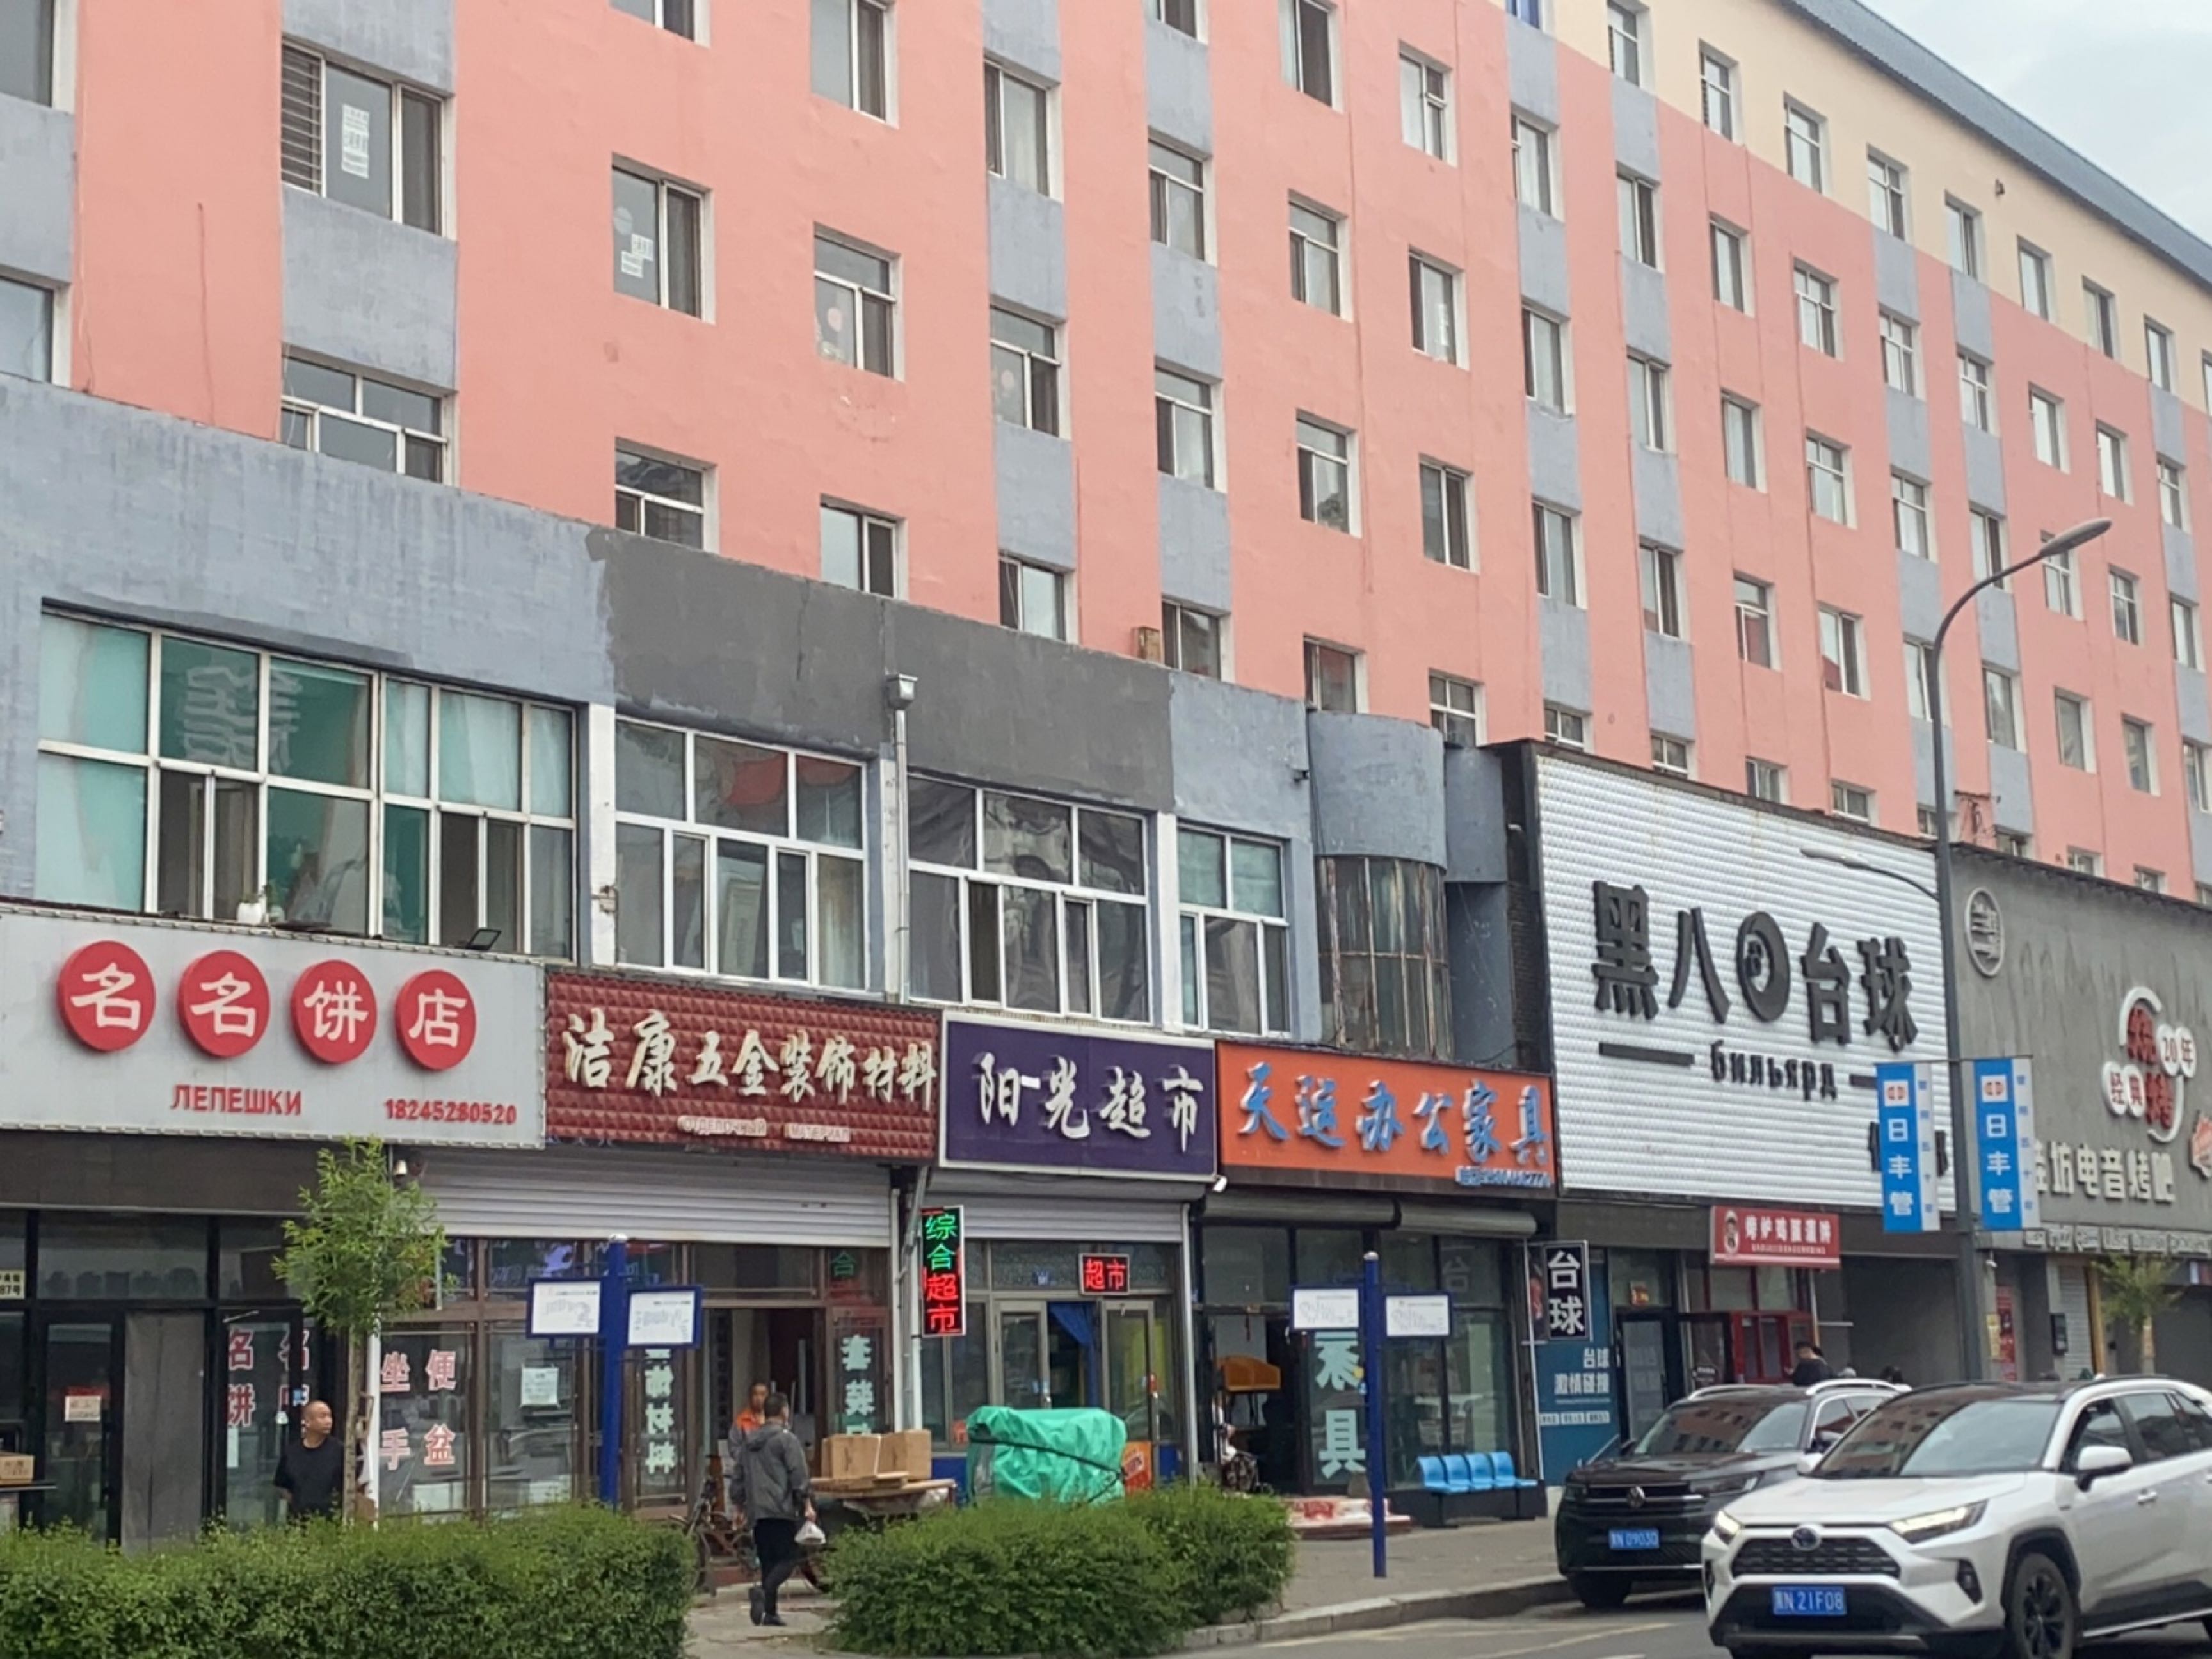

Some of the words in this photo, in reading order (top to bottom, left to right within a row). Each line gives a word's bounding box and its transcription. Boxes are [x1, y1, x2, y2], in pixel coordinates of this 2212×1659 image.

[71, 961, 467, 1047] 名名饼店
[170, 1084, 301, 1116] ЛЕПЕШКИ
[561, 1007, 938, 1111] 洁康五金装饰材料
[977, 1052, 1205, 1152] 阳光超市
[1887, 1118, 1914, 1216] 日丰管
[1985, 1113, 2014, 1214] 日丰管
[925, 1214, 959, 1333] 综合超市
[1084, 1258, 1126, 1291] 超市
[1548, 1249, 1585, 1336] 台球
[381, 1349, 456, 1393] 坐便
[379, 1423, 456, 1471] 手盆
